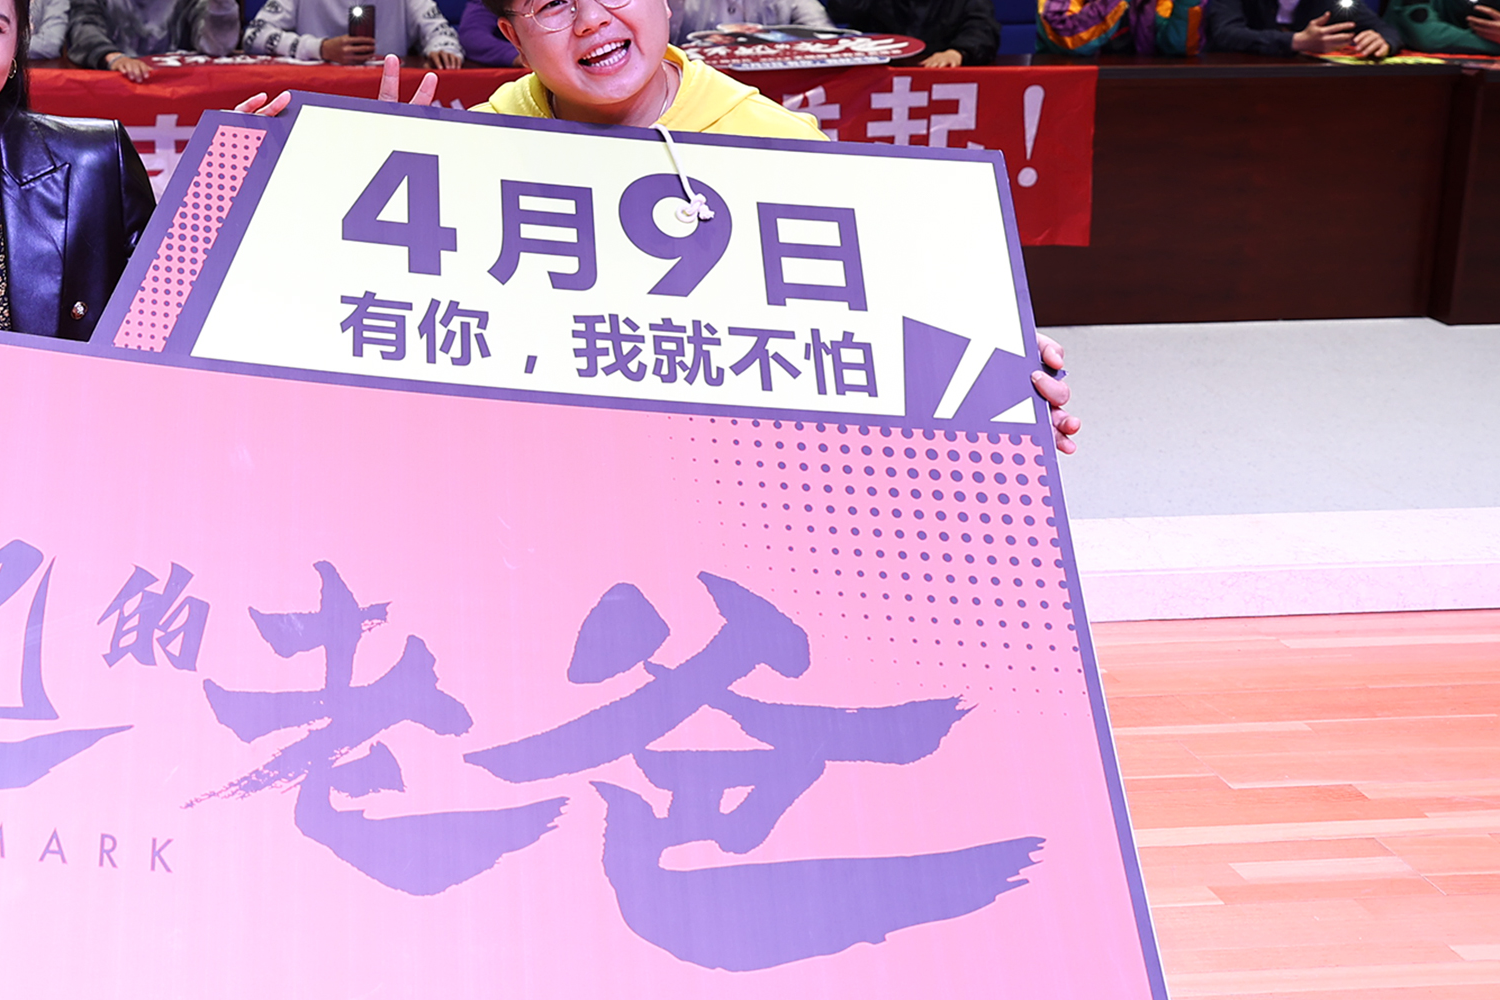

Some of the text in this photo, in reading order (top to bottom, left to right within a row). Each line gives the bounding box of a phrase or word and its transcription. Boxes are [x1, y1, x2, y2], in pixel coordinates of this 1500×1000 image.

[340, 149, 868, 312] 4月9日
[339, 290, 878, 398] 有你，我就不怕
